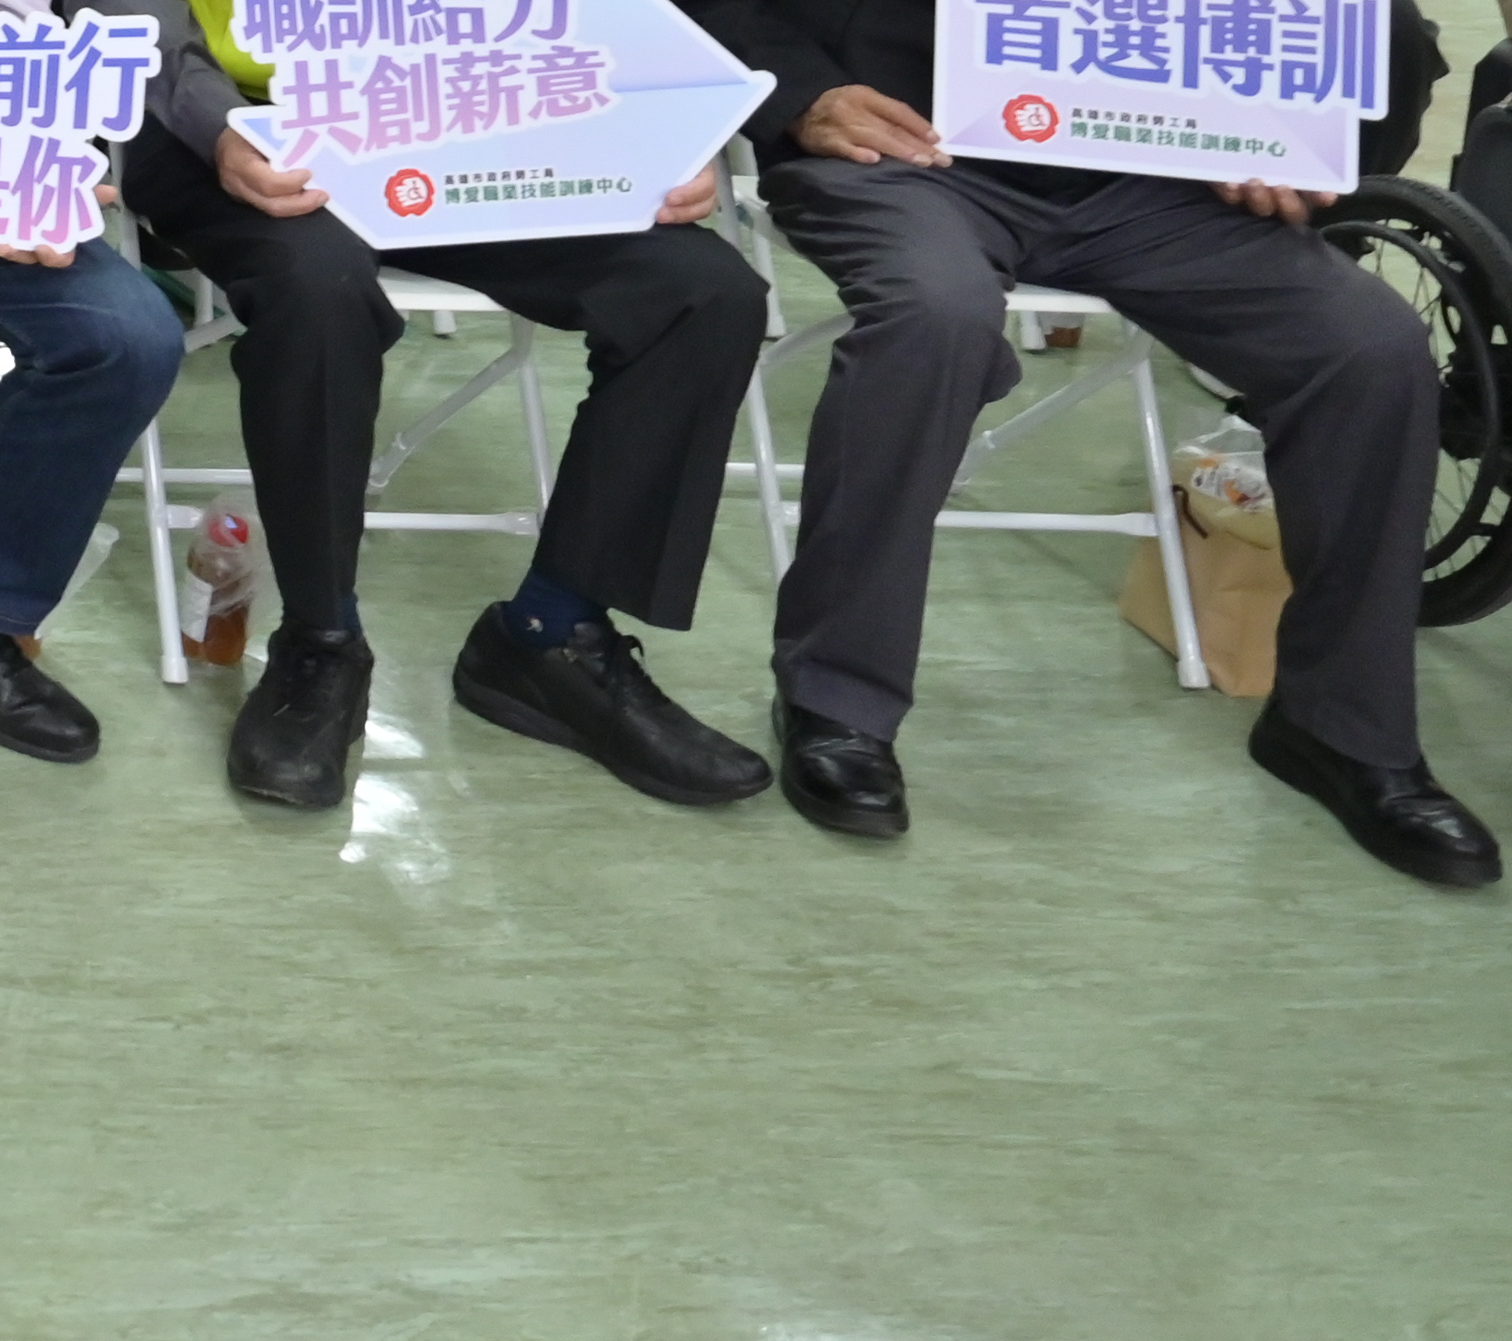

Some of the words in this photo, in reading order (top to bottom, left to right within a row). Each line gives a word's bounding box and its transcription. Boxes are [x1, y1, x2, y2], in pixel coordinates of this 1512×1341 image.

[280, 45, 615, 167] 共創薪意
[1071, 108, 1198, 132] 高雄市政府勞工局
[1069, 120, 1287, 158] 博愛職業技能訓練中心
[443, 167, 555, 187] 高雄市政府勞工局
[444, 176, 634, 207] 博愛職業技能訓練中心
